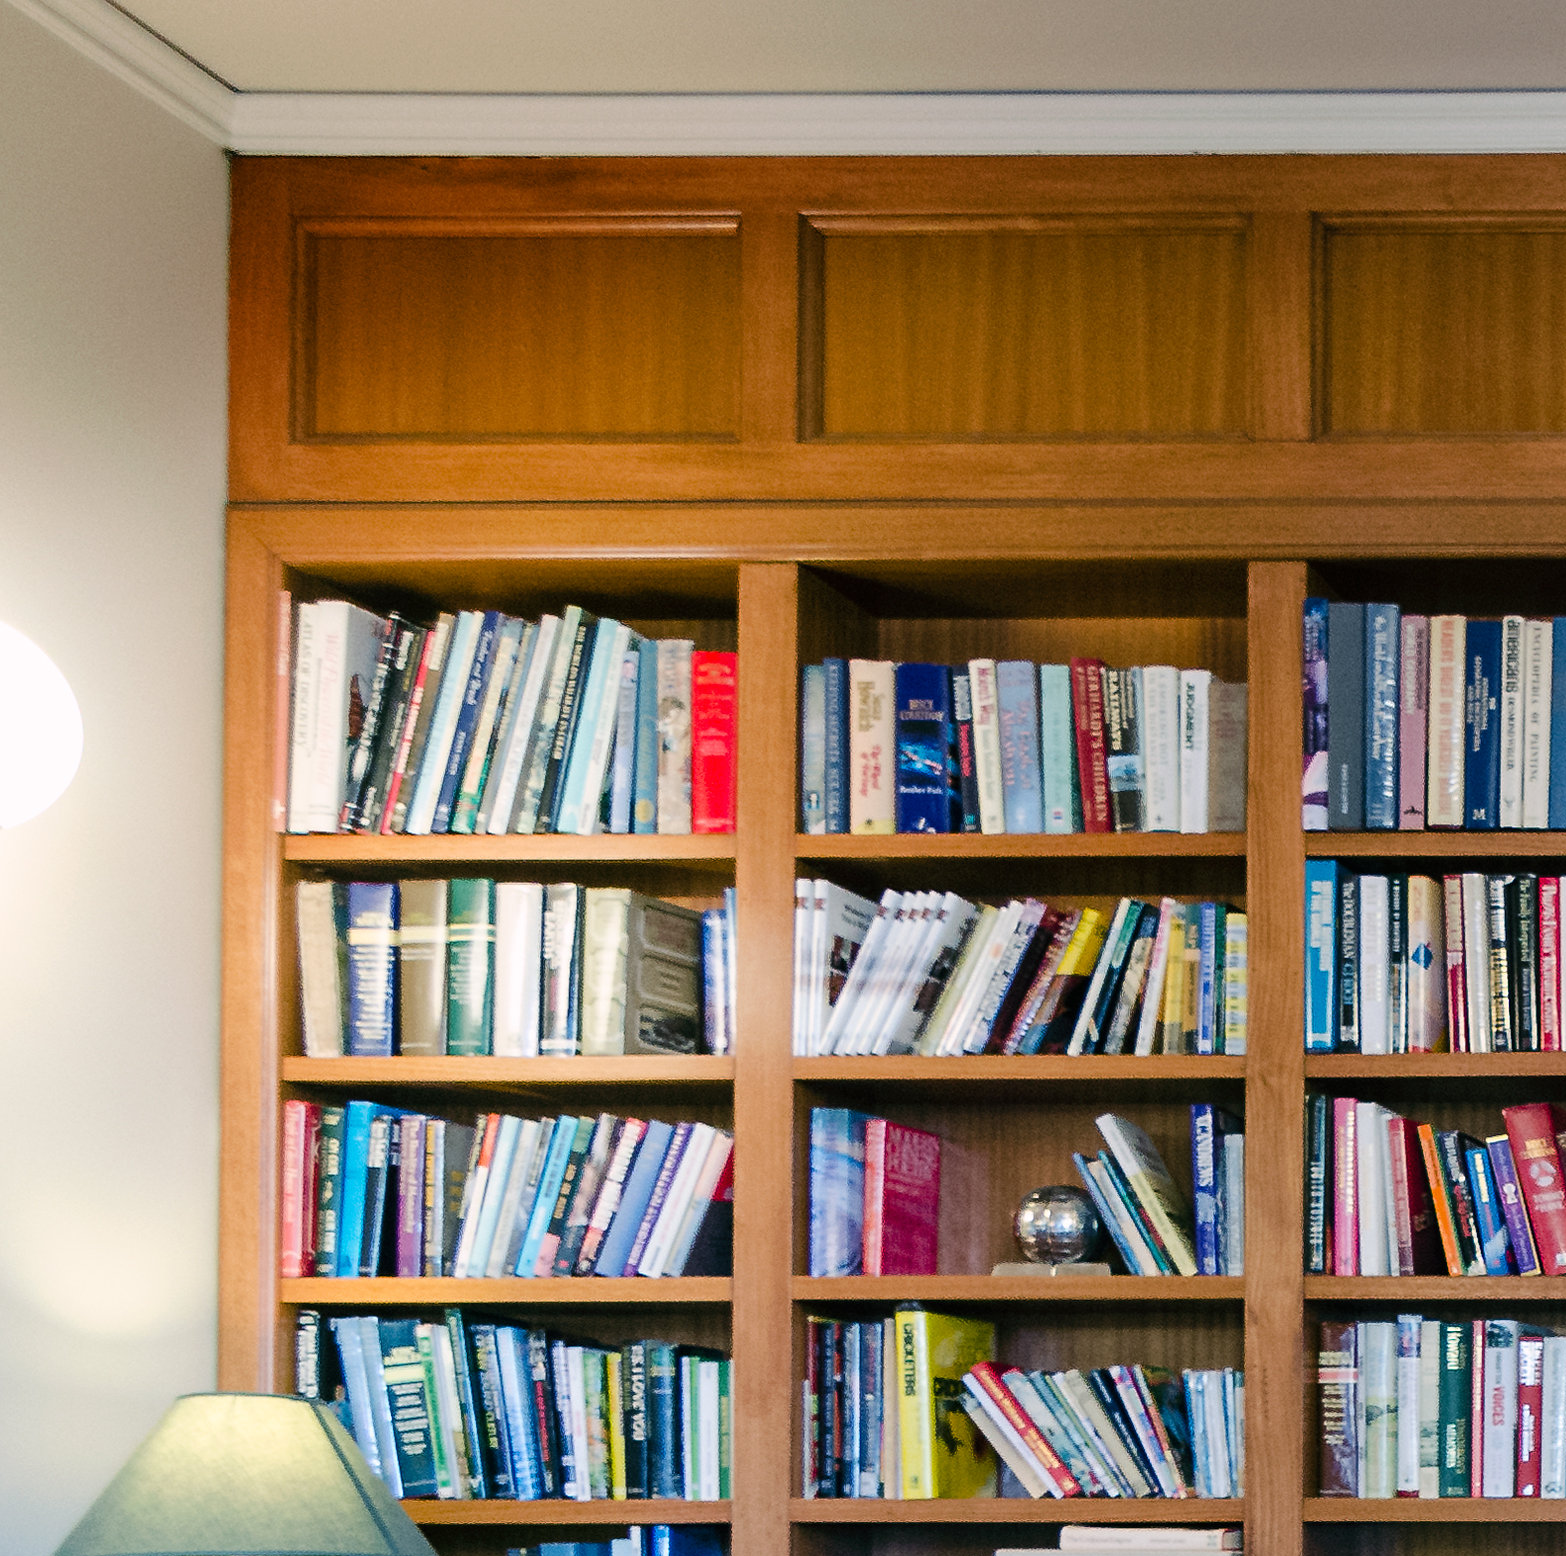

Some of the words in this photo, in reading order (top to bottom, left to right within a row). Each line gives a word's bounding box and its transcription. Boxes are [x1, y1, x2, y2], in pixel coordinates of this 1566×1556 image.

[1108, 671, 1122, 750] RAILWAYS
[1185, 682, 1195, 751] JUDGMENT
[1531, 712, 1540, 724] OF
[1529, 733, 1539, 782] PAINTING
[902, 1323, 915, 1396] CRICKETERS
[1446, 1326, 1460, 1370] Howard
